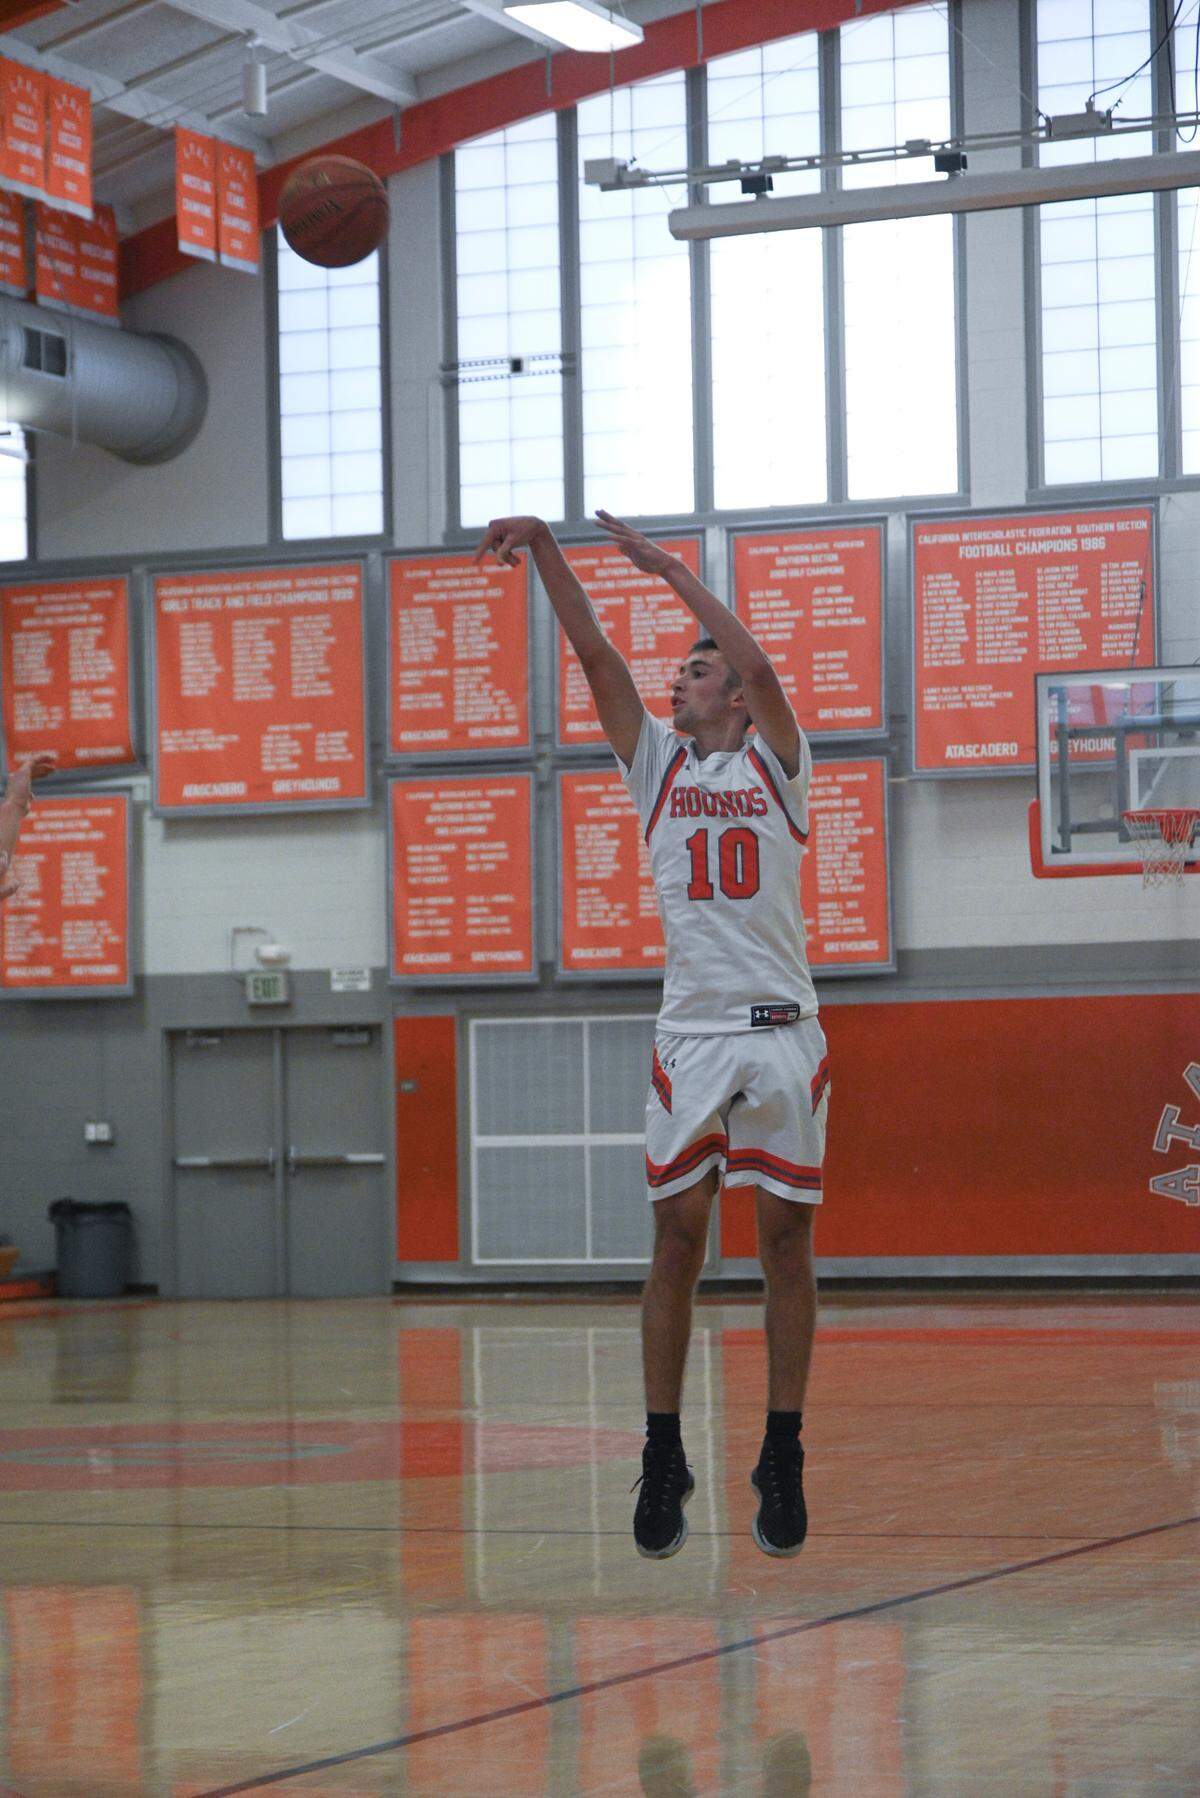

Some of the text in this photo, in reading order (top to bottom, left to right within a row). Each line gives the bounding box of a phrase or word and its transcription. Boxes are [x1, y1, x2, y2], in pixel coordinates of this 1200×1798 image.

[918, 519, 1147, 545] CALIFORNIA INTERSCHOLASTIC FEDERATION SOUTHERN SECTION
[959, 543, 1012, 559] FOOTBALL
[1015, 538, 1078, 556] CHAMPIONS
[945, 742, 1018, 759] ATASCADERO
[670, 785, 768, 818] HOUNDS
[685, 827, 761, 901] 10
